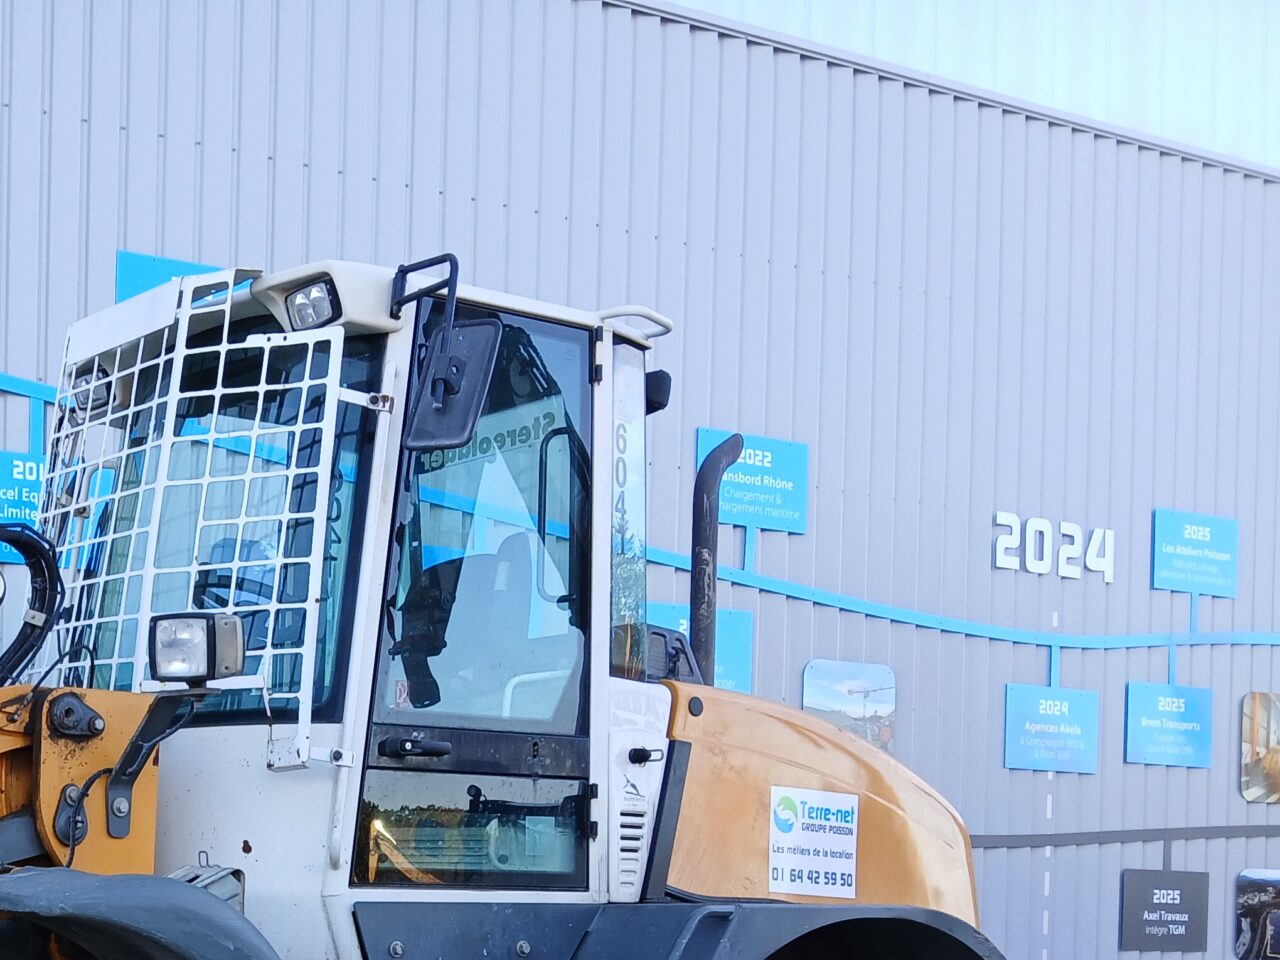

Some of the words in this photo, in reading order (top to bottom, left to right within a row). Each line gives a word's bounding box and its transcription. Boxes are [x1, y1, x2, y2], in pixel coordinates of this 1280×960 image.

[722, 471, 761, 486] ansbord
[764, 475, 794, 490] Rhône
[724, 487, 774, 503] Chargement
[719, 500, 763, 515] hargement
[766, 506, 800, 520] maritime
[1184, 524, 1211, 542] 2025
[995, 510, 1115, 583] 2024
[1039, 699, 1069, 716] 2024
[1158, 696, 1186, 713] 2025
[1024, 720, 1058, 734] Agences
[1060, 723, 1082, 735] Akela
[1162, 718, 1200, 732] Transports
[800, 800, 855, 824] Terre-net
[801, 822, 827, 834] GROUPE
[828, 825, 853, 836] POISSON
[772, 843, 784, 853] Les
[786, 844, 811, 856] métiers
[812, 847, 821, 857] de
[822, 848, 828, 858] la
[829, 848, 854, 860] location
[772, 867, 784, 881] 01
[789, 868, 803, 883] 64
[807, 869, 820, 885] 42
[824, 871, 837, 886] 59
[840, 872, 853, 887] 50
[1153, 889, 1181, 904] 2025
[1143, 910, 1160, 921] Axel
[1160, 911, 1189, 921] Travaux
[1145, 924, 1168, 936] intègre
[1168, 924, 1186, 935] TGM
